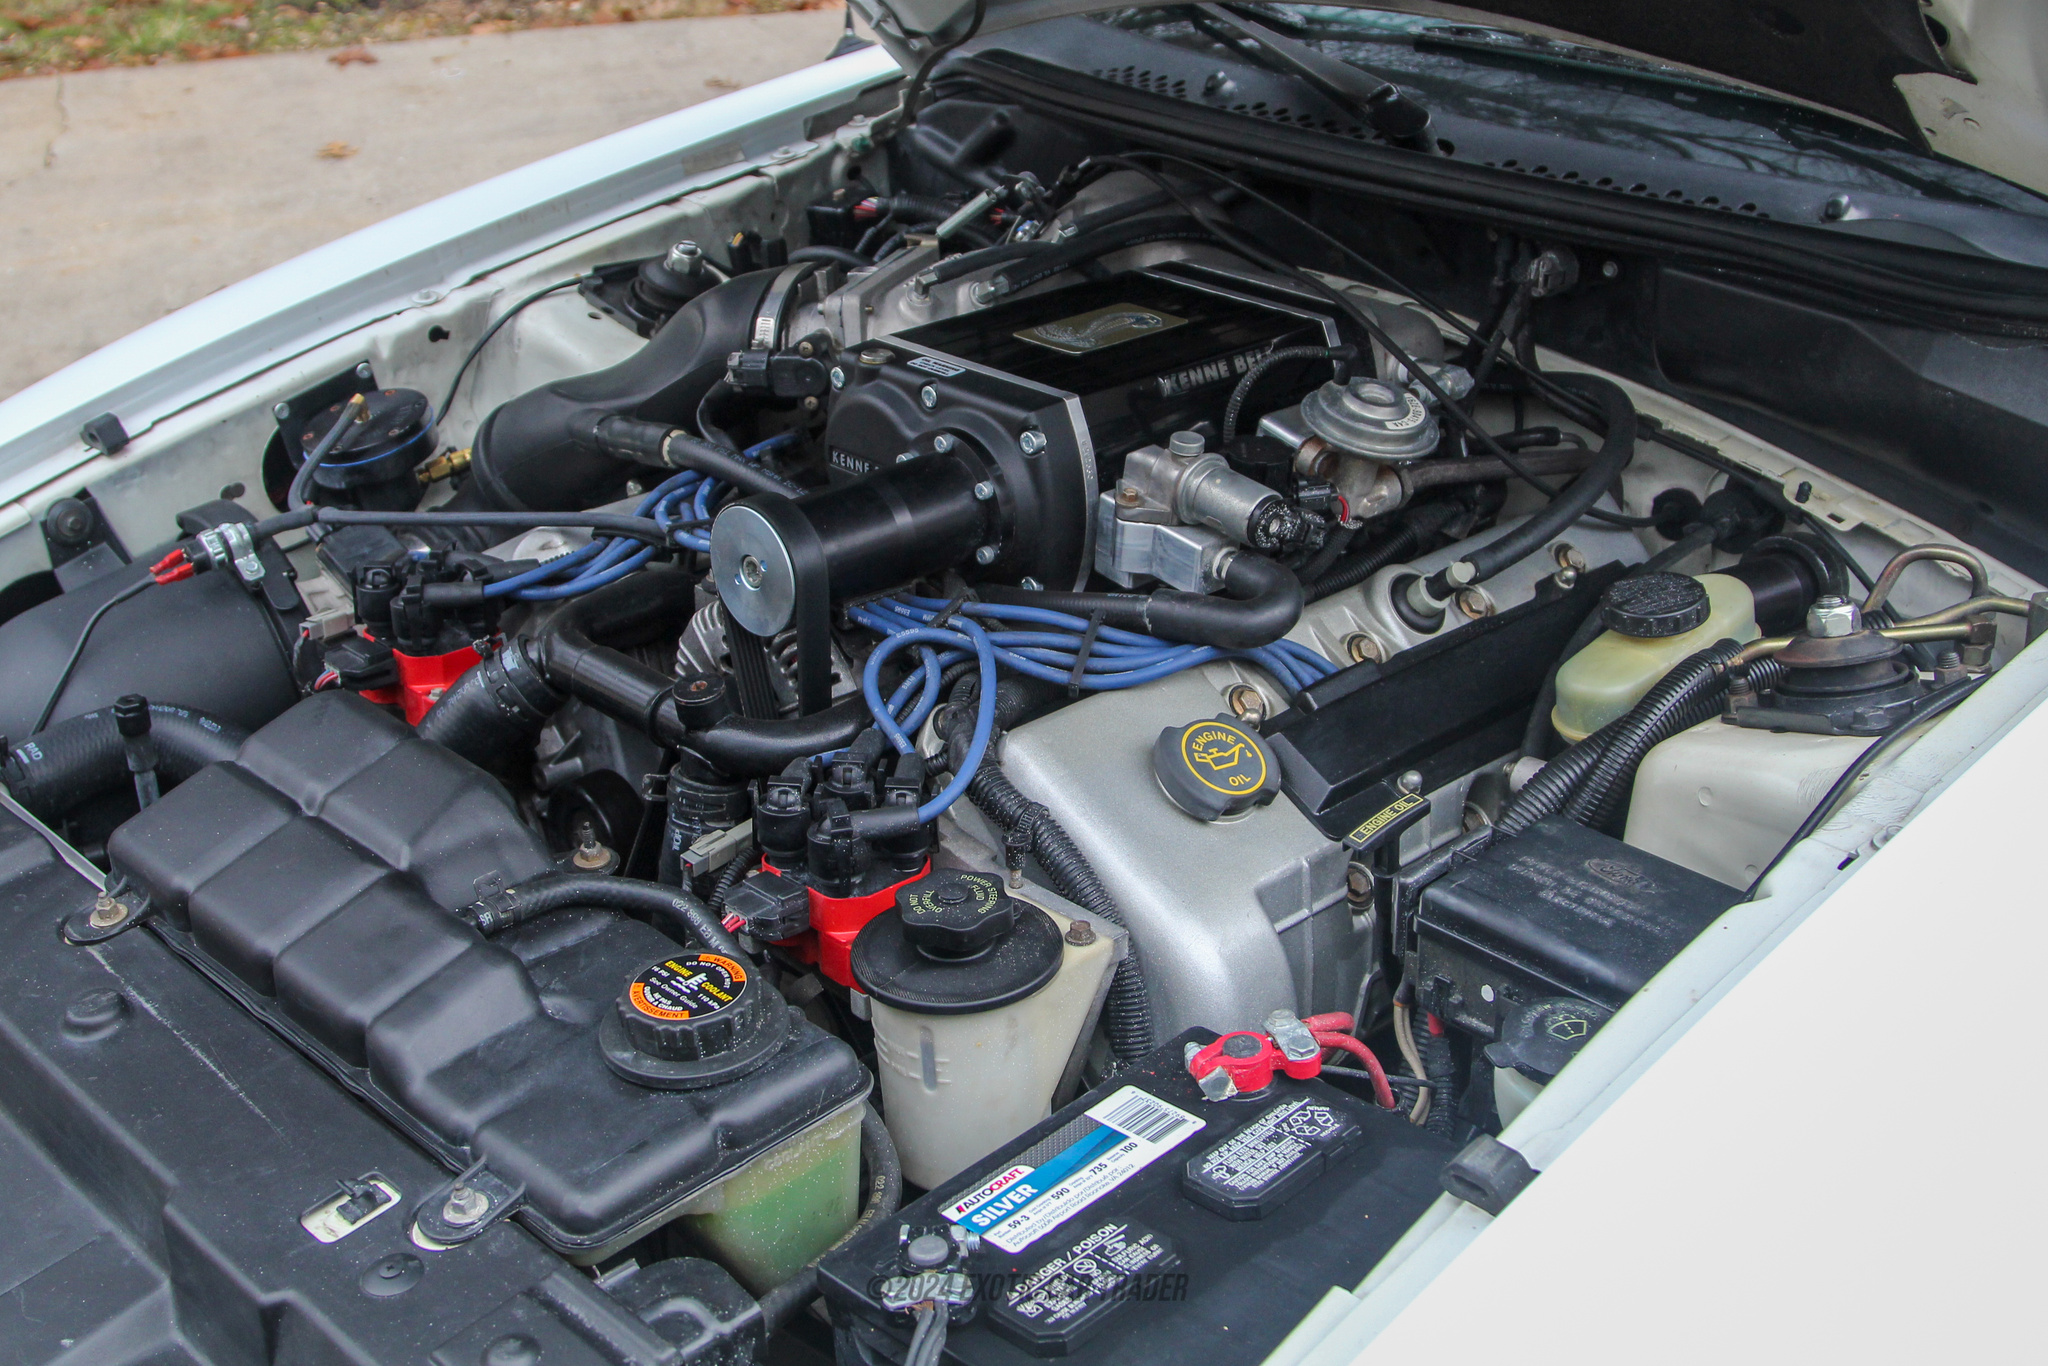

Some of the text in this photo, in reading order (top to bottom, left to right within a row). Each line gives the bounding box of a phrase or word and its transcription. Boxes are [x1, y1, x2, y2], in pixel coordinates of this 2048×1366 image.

[1164, 359, 1230, 393] KENNE
[24, 741, 44, 760] RAD
[1192, 730, 1236, 752] ENGINE
[1228, 774, 1252, 787] OIL
[1361, 797, 1416, 836] ENGINE OIL
[909, 893, 927, 915] DO NOT
[921, 890, 943, 914] OVERFILL
[960, 874, 998, 914] POWER STEERING
[971, 884, 985, 901] FLUID
[664, 960, 694, 978] ENGINE
[714, 956, 743, 980] WARNING
[701, 981, 733, 1002] COOLANT
[632, 991, 685, 1018] AVERTISSEMENT
[658, 1003, 684, 1011] CHAUD
[963, 1168, 1025, 1210] AUTOCRAFT
[1007, 1142, 1138, 1229] 59-3 590 735 100
[971, 1183, 1039, 1226] SILVER
[1014, 1257, 1067, 1293] DANGER
[1072, 1223, 1119, 1255] POISON
